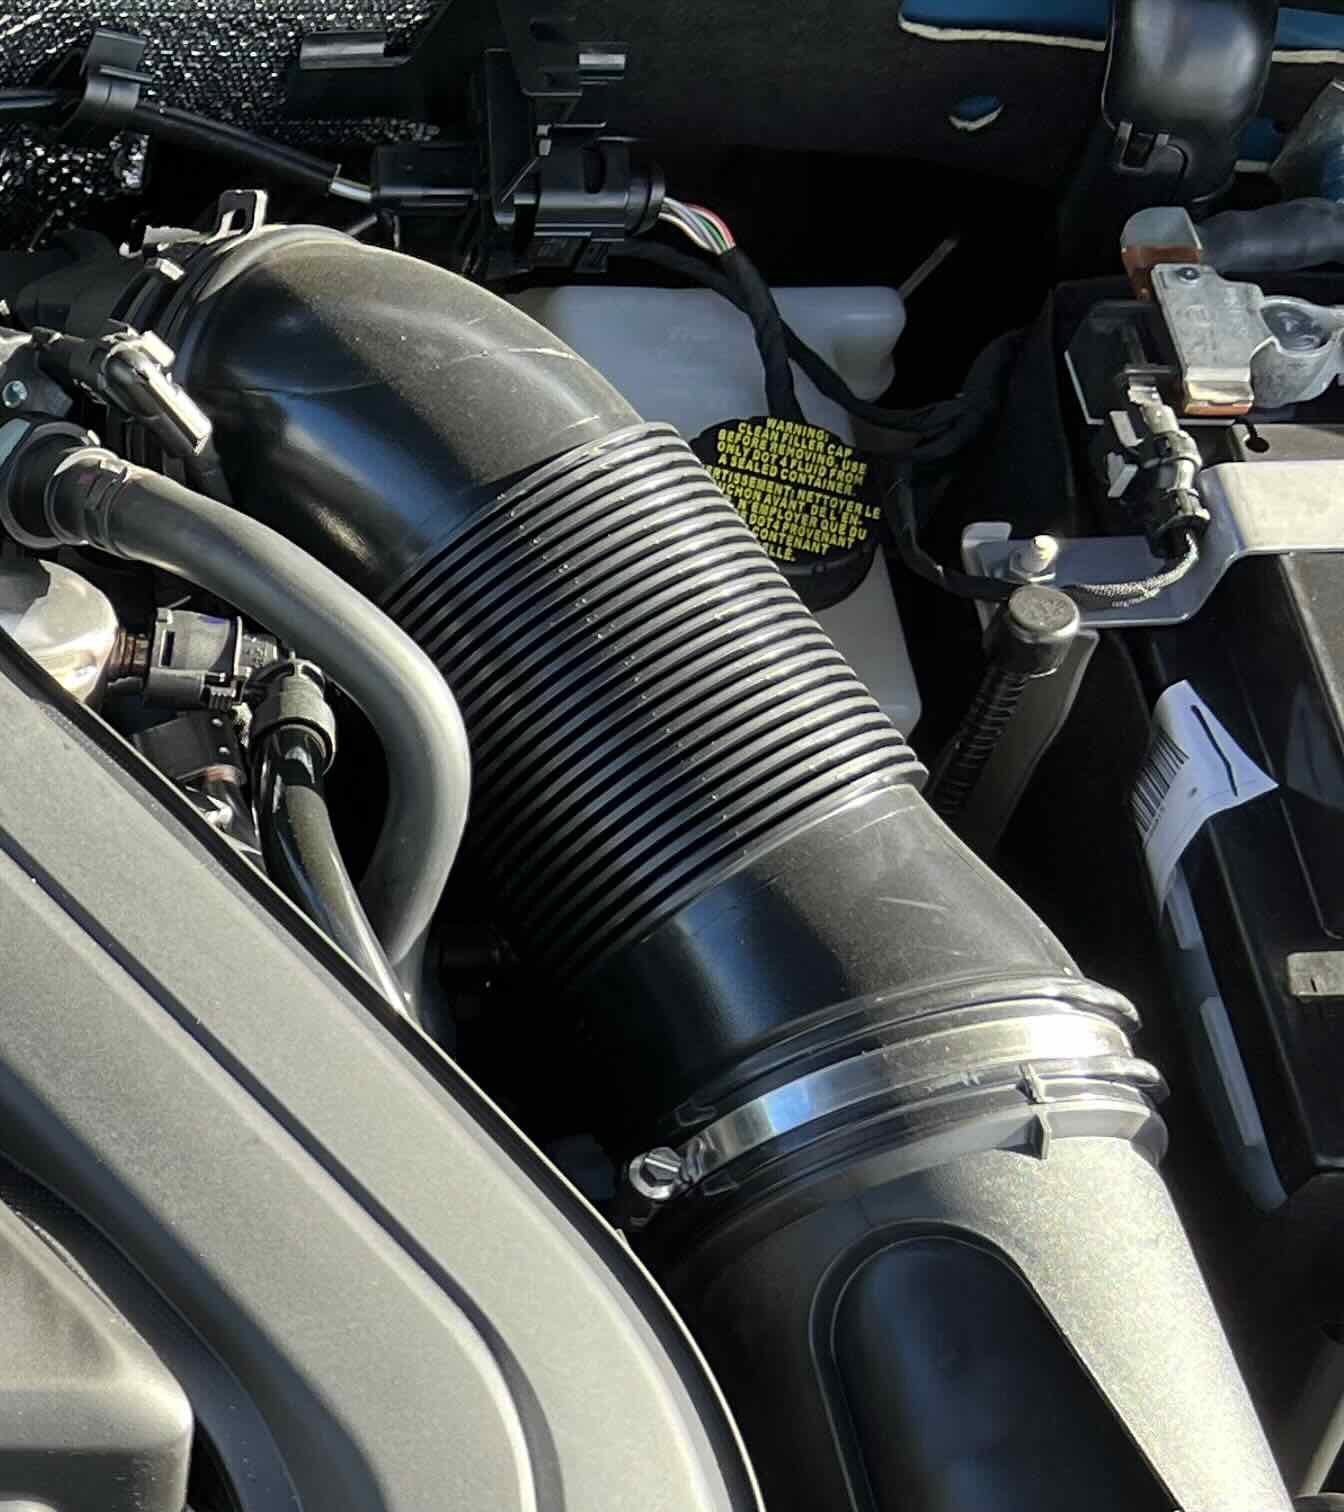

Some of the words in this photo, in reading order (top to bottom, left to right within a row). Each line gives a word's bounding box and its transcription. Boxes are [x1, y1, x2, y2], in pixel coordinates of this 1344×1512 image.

[718, 429, 769, 450] BEFORE
[842, 459, 867, 475] USE
[738, 422, 779, 441] CLEAN
[782, 432, 825, 453] FILLER
[827, 444, 853, 457] CAP
[717, 441, 749, 458] ONLY
[752, 449, 777, 464] DOT
[779, 455, 787, 467] 4
[790, 458, 827, 476] FLUID
[829, 468, 864, 485] FROM
[718, 454, 727, 465] A
[730, 456, 778, 477] SEALED
[764, 493, 806, 512] AVANT
[797, 489, 862, 514] NETTOYER
[865, 505, 881, 519] LE
[782, 522, 855, 549] PROVENANT
[820, 520, 846, 535] QUE
[849, 525, 867, 540] DU
